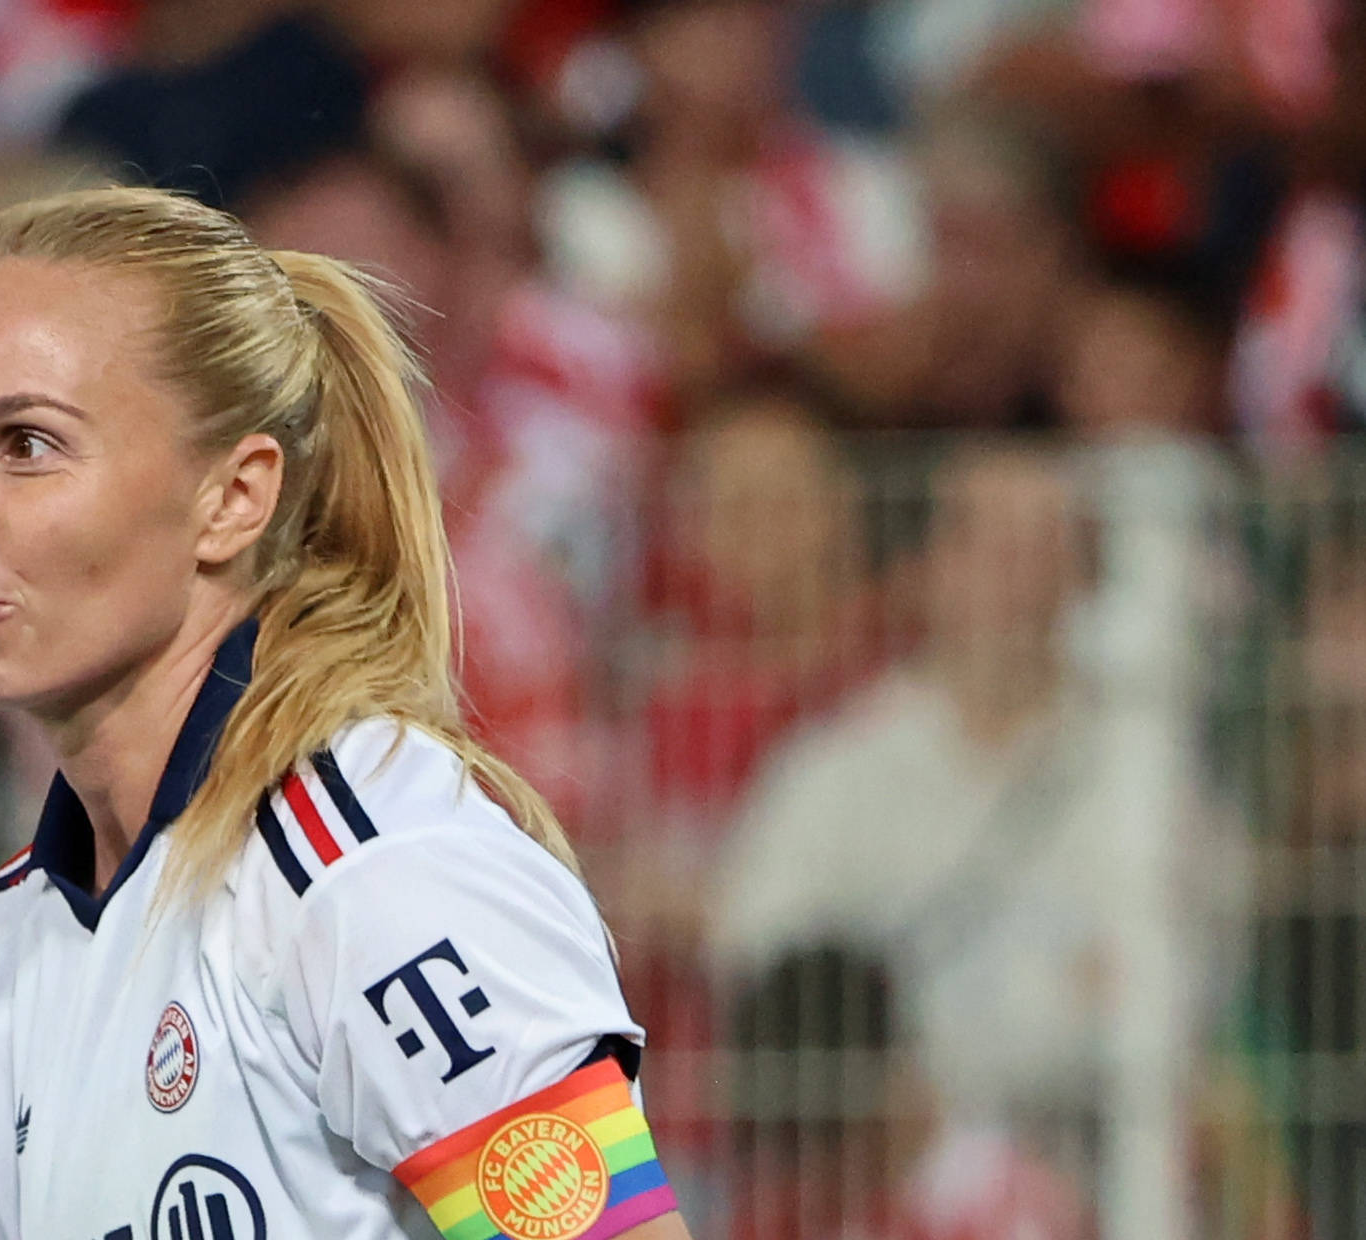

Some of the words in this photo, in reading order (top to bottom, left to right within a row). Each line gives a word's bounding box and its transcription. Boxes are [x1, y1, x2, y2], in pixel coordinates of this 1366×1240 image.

[363, 937, 496, 1085] T
[485, 1161, 503, 1192] FC
[494, 1120, 584, 1157] BAYERN
